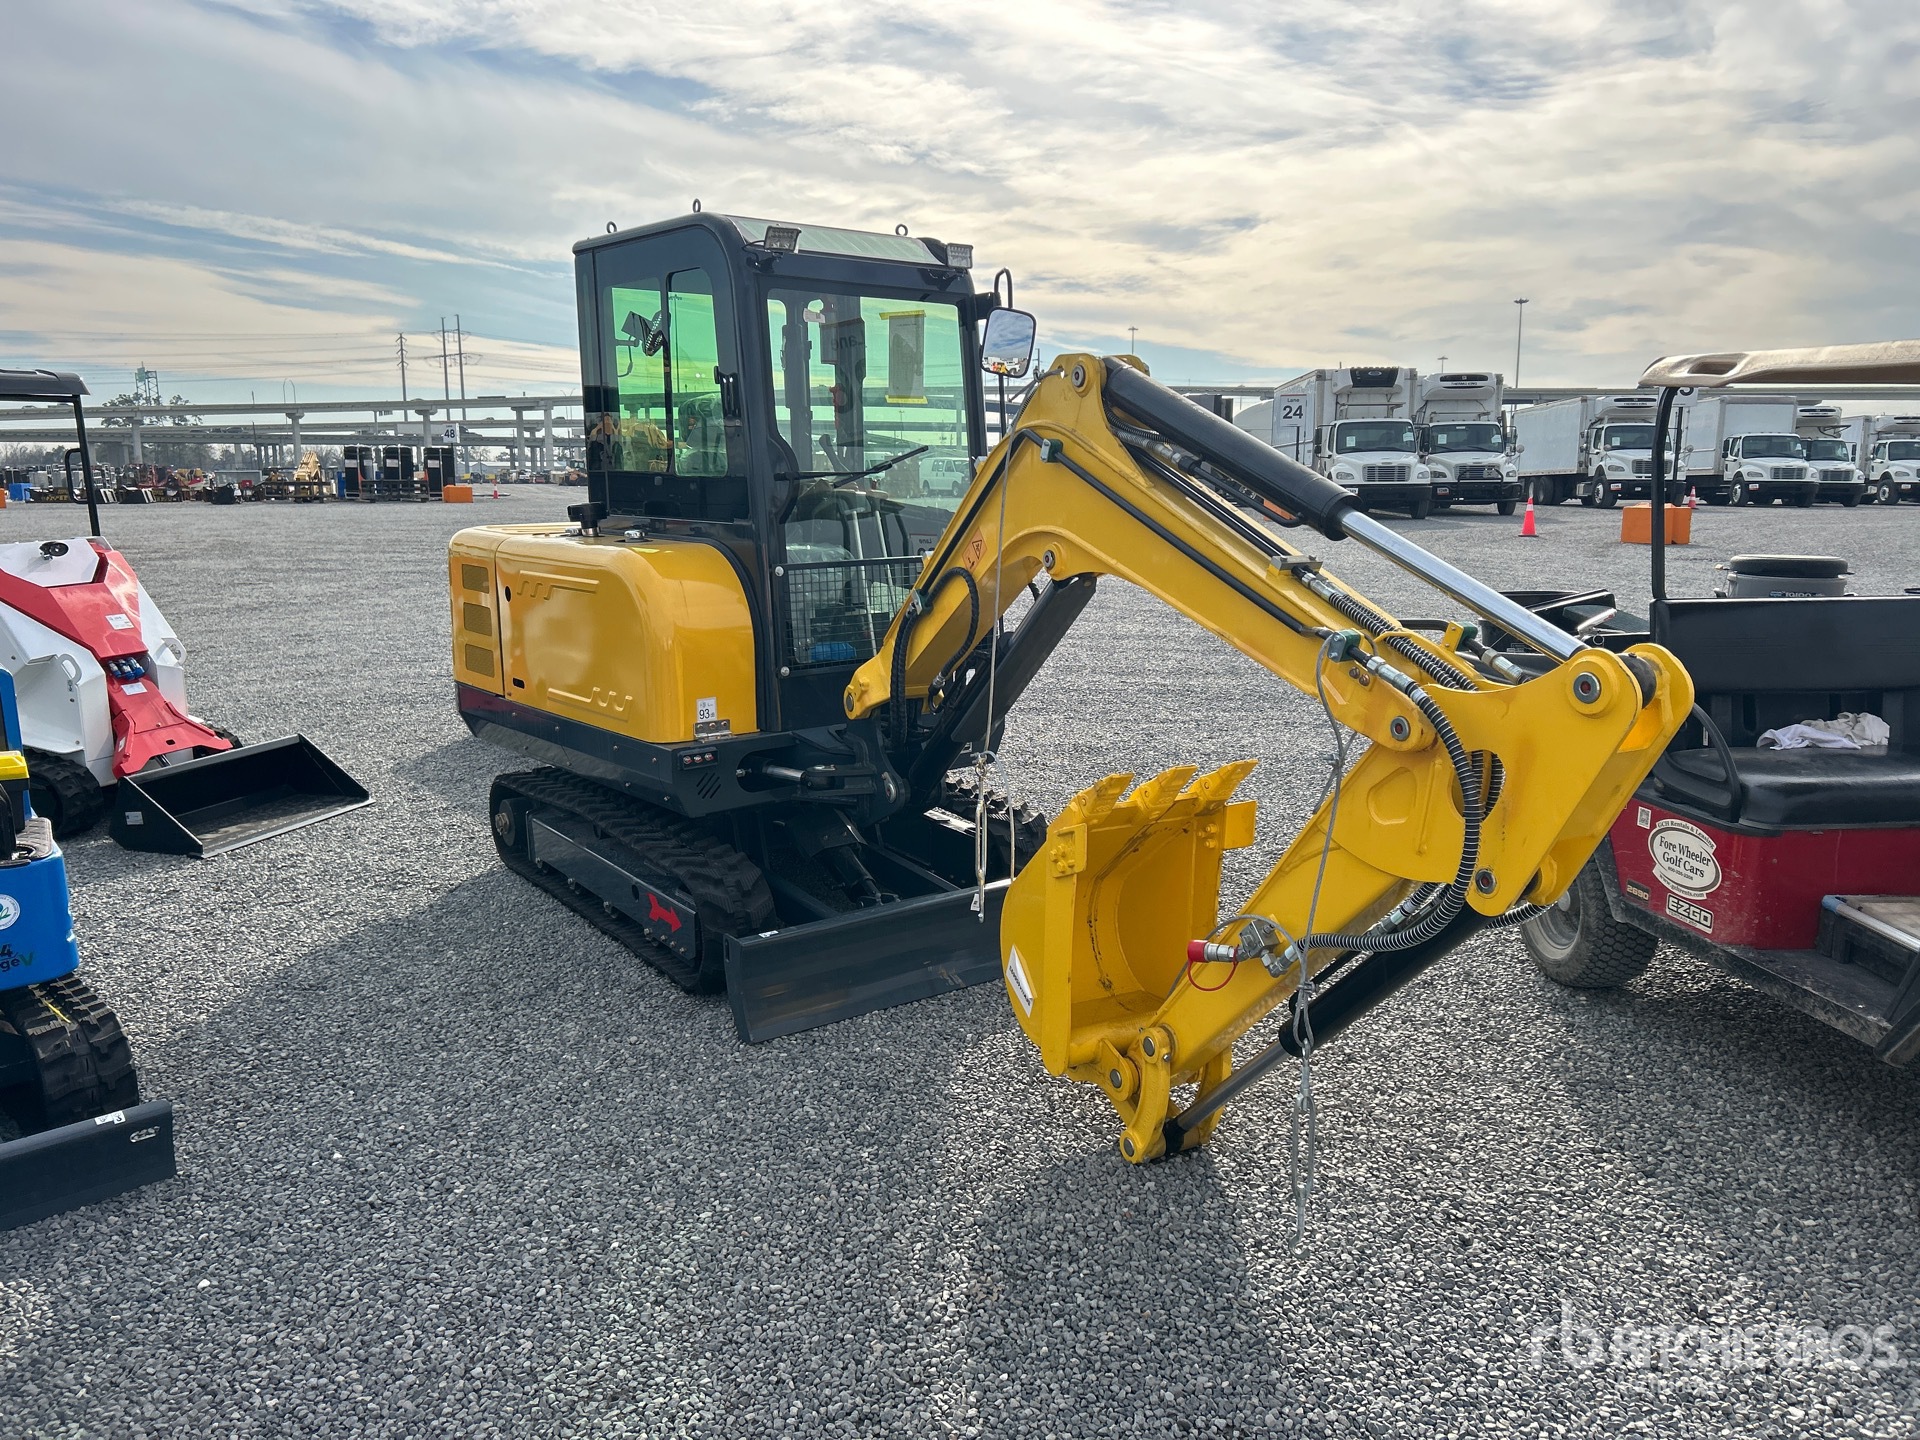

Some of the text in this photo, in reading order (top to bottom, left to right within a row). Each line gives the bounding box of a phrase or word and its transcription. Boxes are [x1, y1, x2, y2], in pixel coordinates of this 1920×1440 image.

[1282, 405, 1303, 419] 24
[444, 429, 455, 438] 48
[699, 709, 710, 720] 93
[1657, 820, 1670, 828] GCH
[1670, 820, 1690, 830] Rentals
[1695, 828, 1715, 850] Leasing
[1659, 835, 1711, 867] Fore Wheeler
[1662, 851, 1705, 878] Golf Cars
[1626, 884, 1649, 901] 2690
[1668, 895, 1713, 928] EZGO
